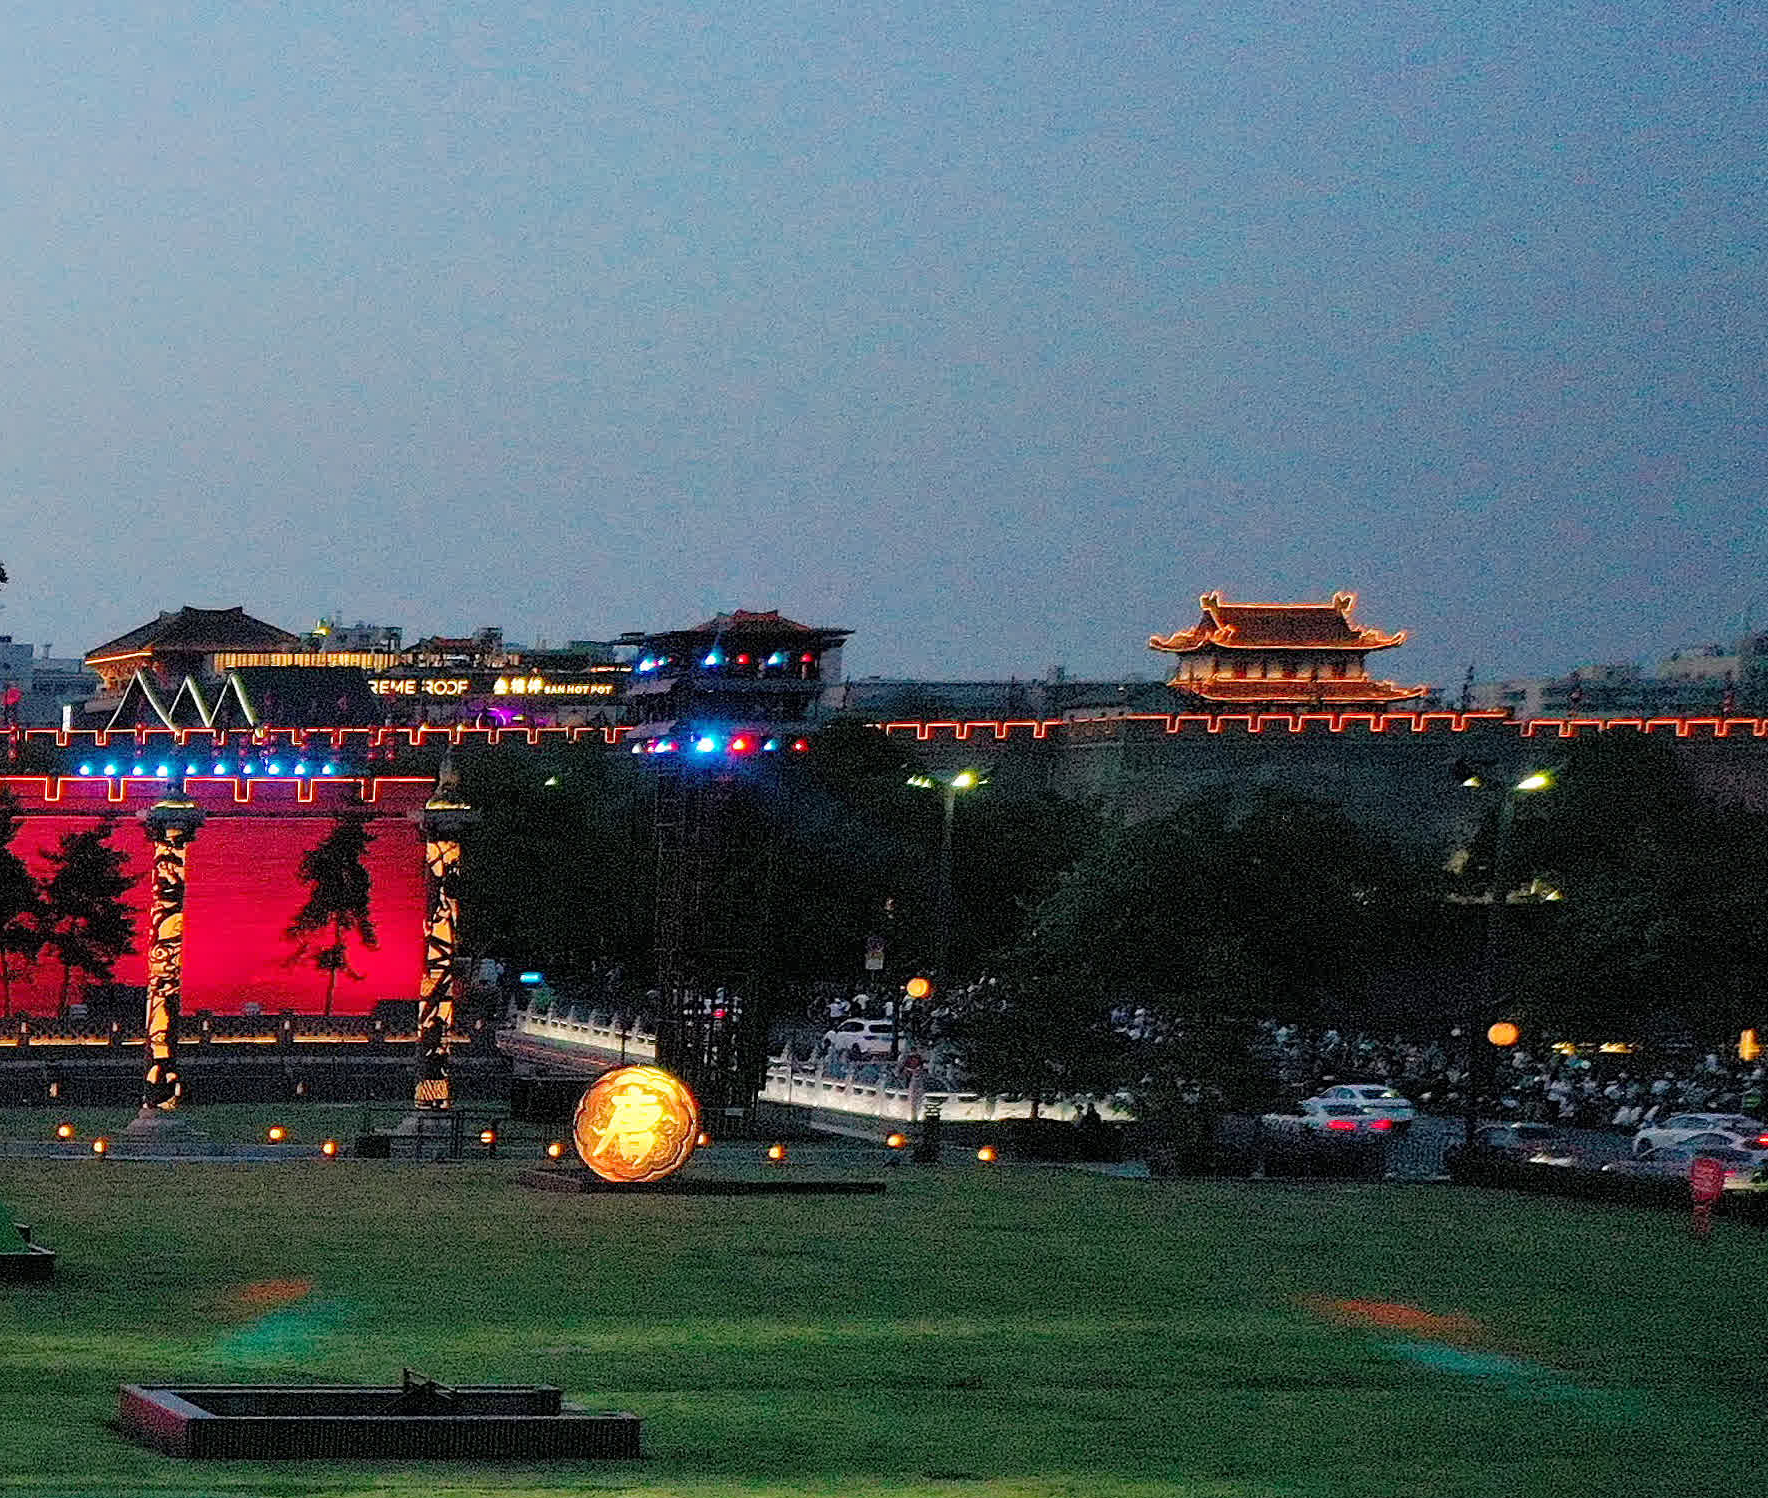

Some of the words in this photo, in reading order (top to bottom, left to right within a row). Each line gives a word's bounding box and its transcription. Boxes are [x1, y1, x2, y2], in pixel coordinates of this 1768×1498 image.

[566, 684, 589, 695] HOT
[590, 684, 613, 695] POT
[593, 1085, 663, 1160] 唐
